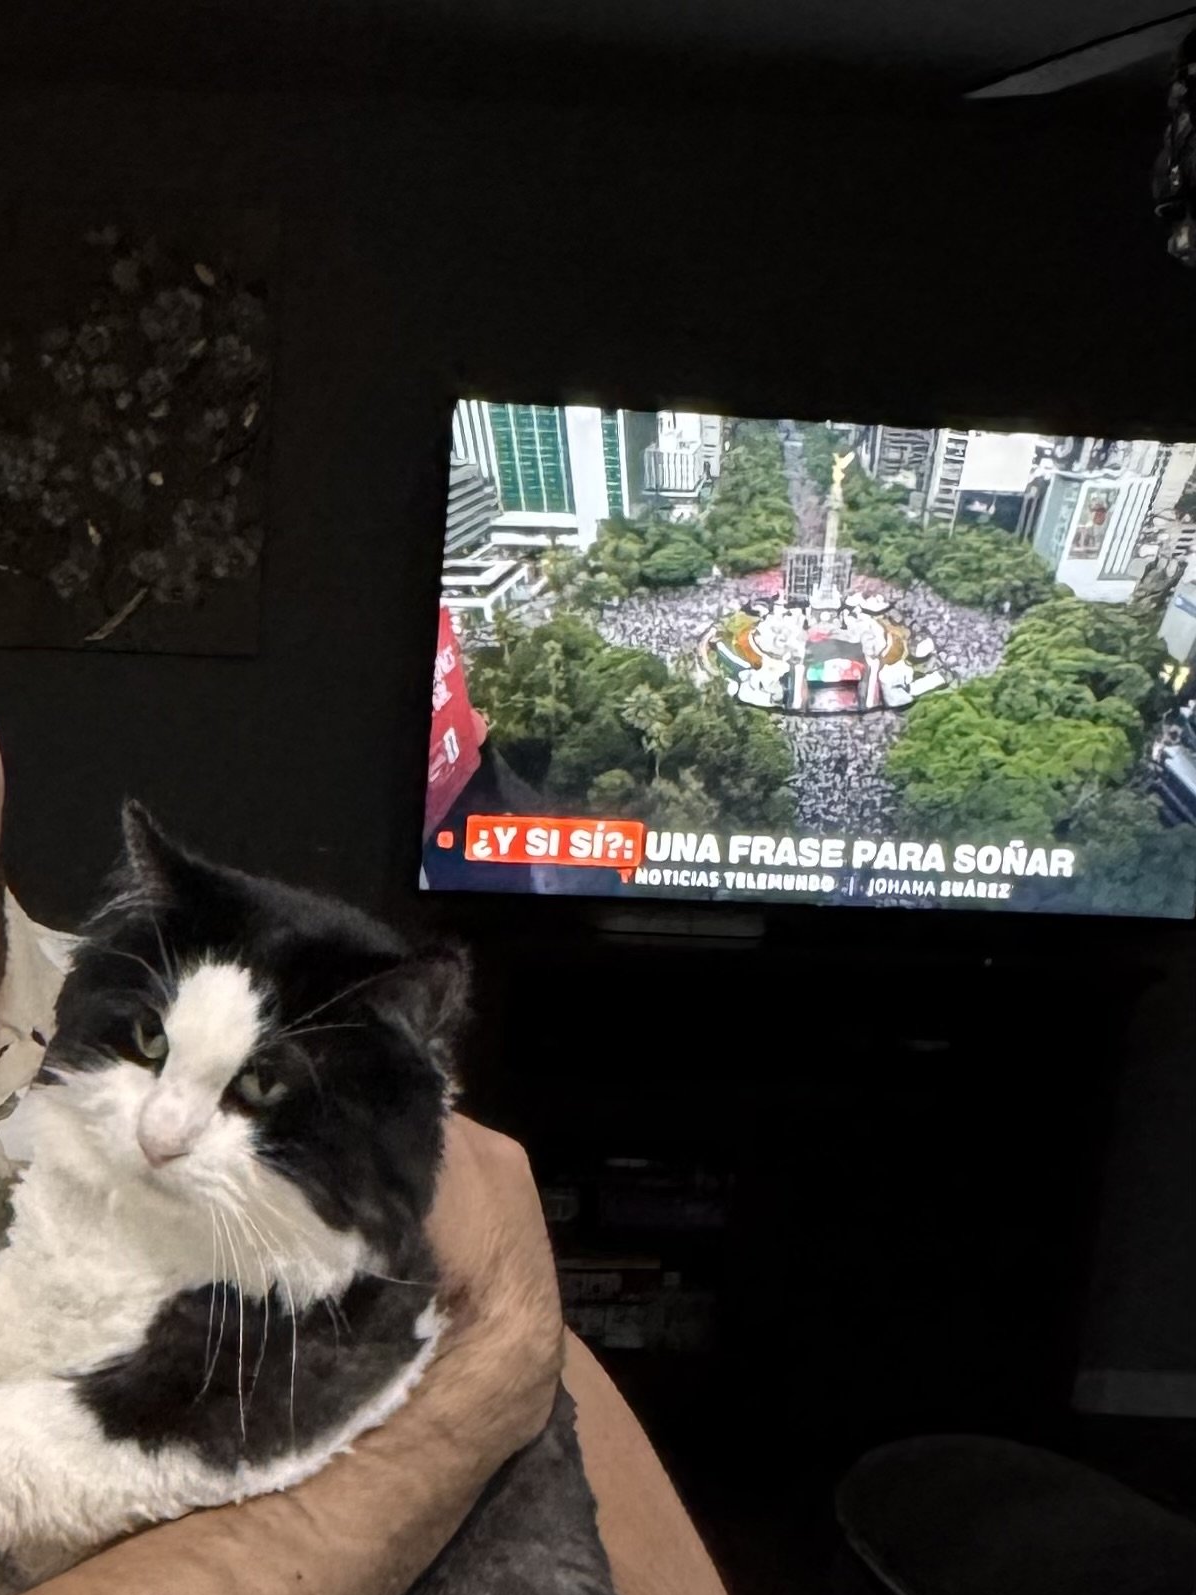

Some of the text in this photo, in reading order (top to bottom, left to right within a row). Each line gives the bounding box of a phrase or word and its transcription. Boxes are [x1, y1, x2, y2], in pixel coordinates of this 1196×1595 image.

[472, 826, 517, 859] ¿Y
[526, 827, 561, 857] SI
[645, 831, 721, 863] UNA
[728, 834, 845, 868] FRASE
[852, 839, 945, 872] PARA
[953, 840, 1075, 877] SOÑAR
[635, 867, 720, 888] NOTICIAS
[724, 871, 836, 892] TELEMUNDO
